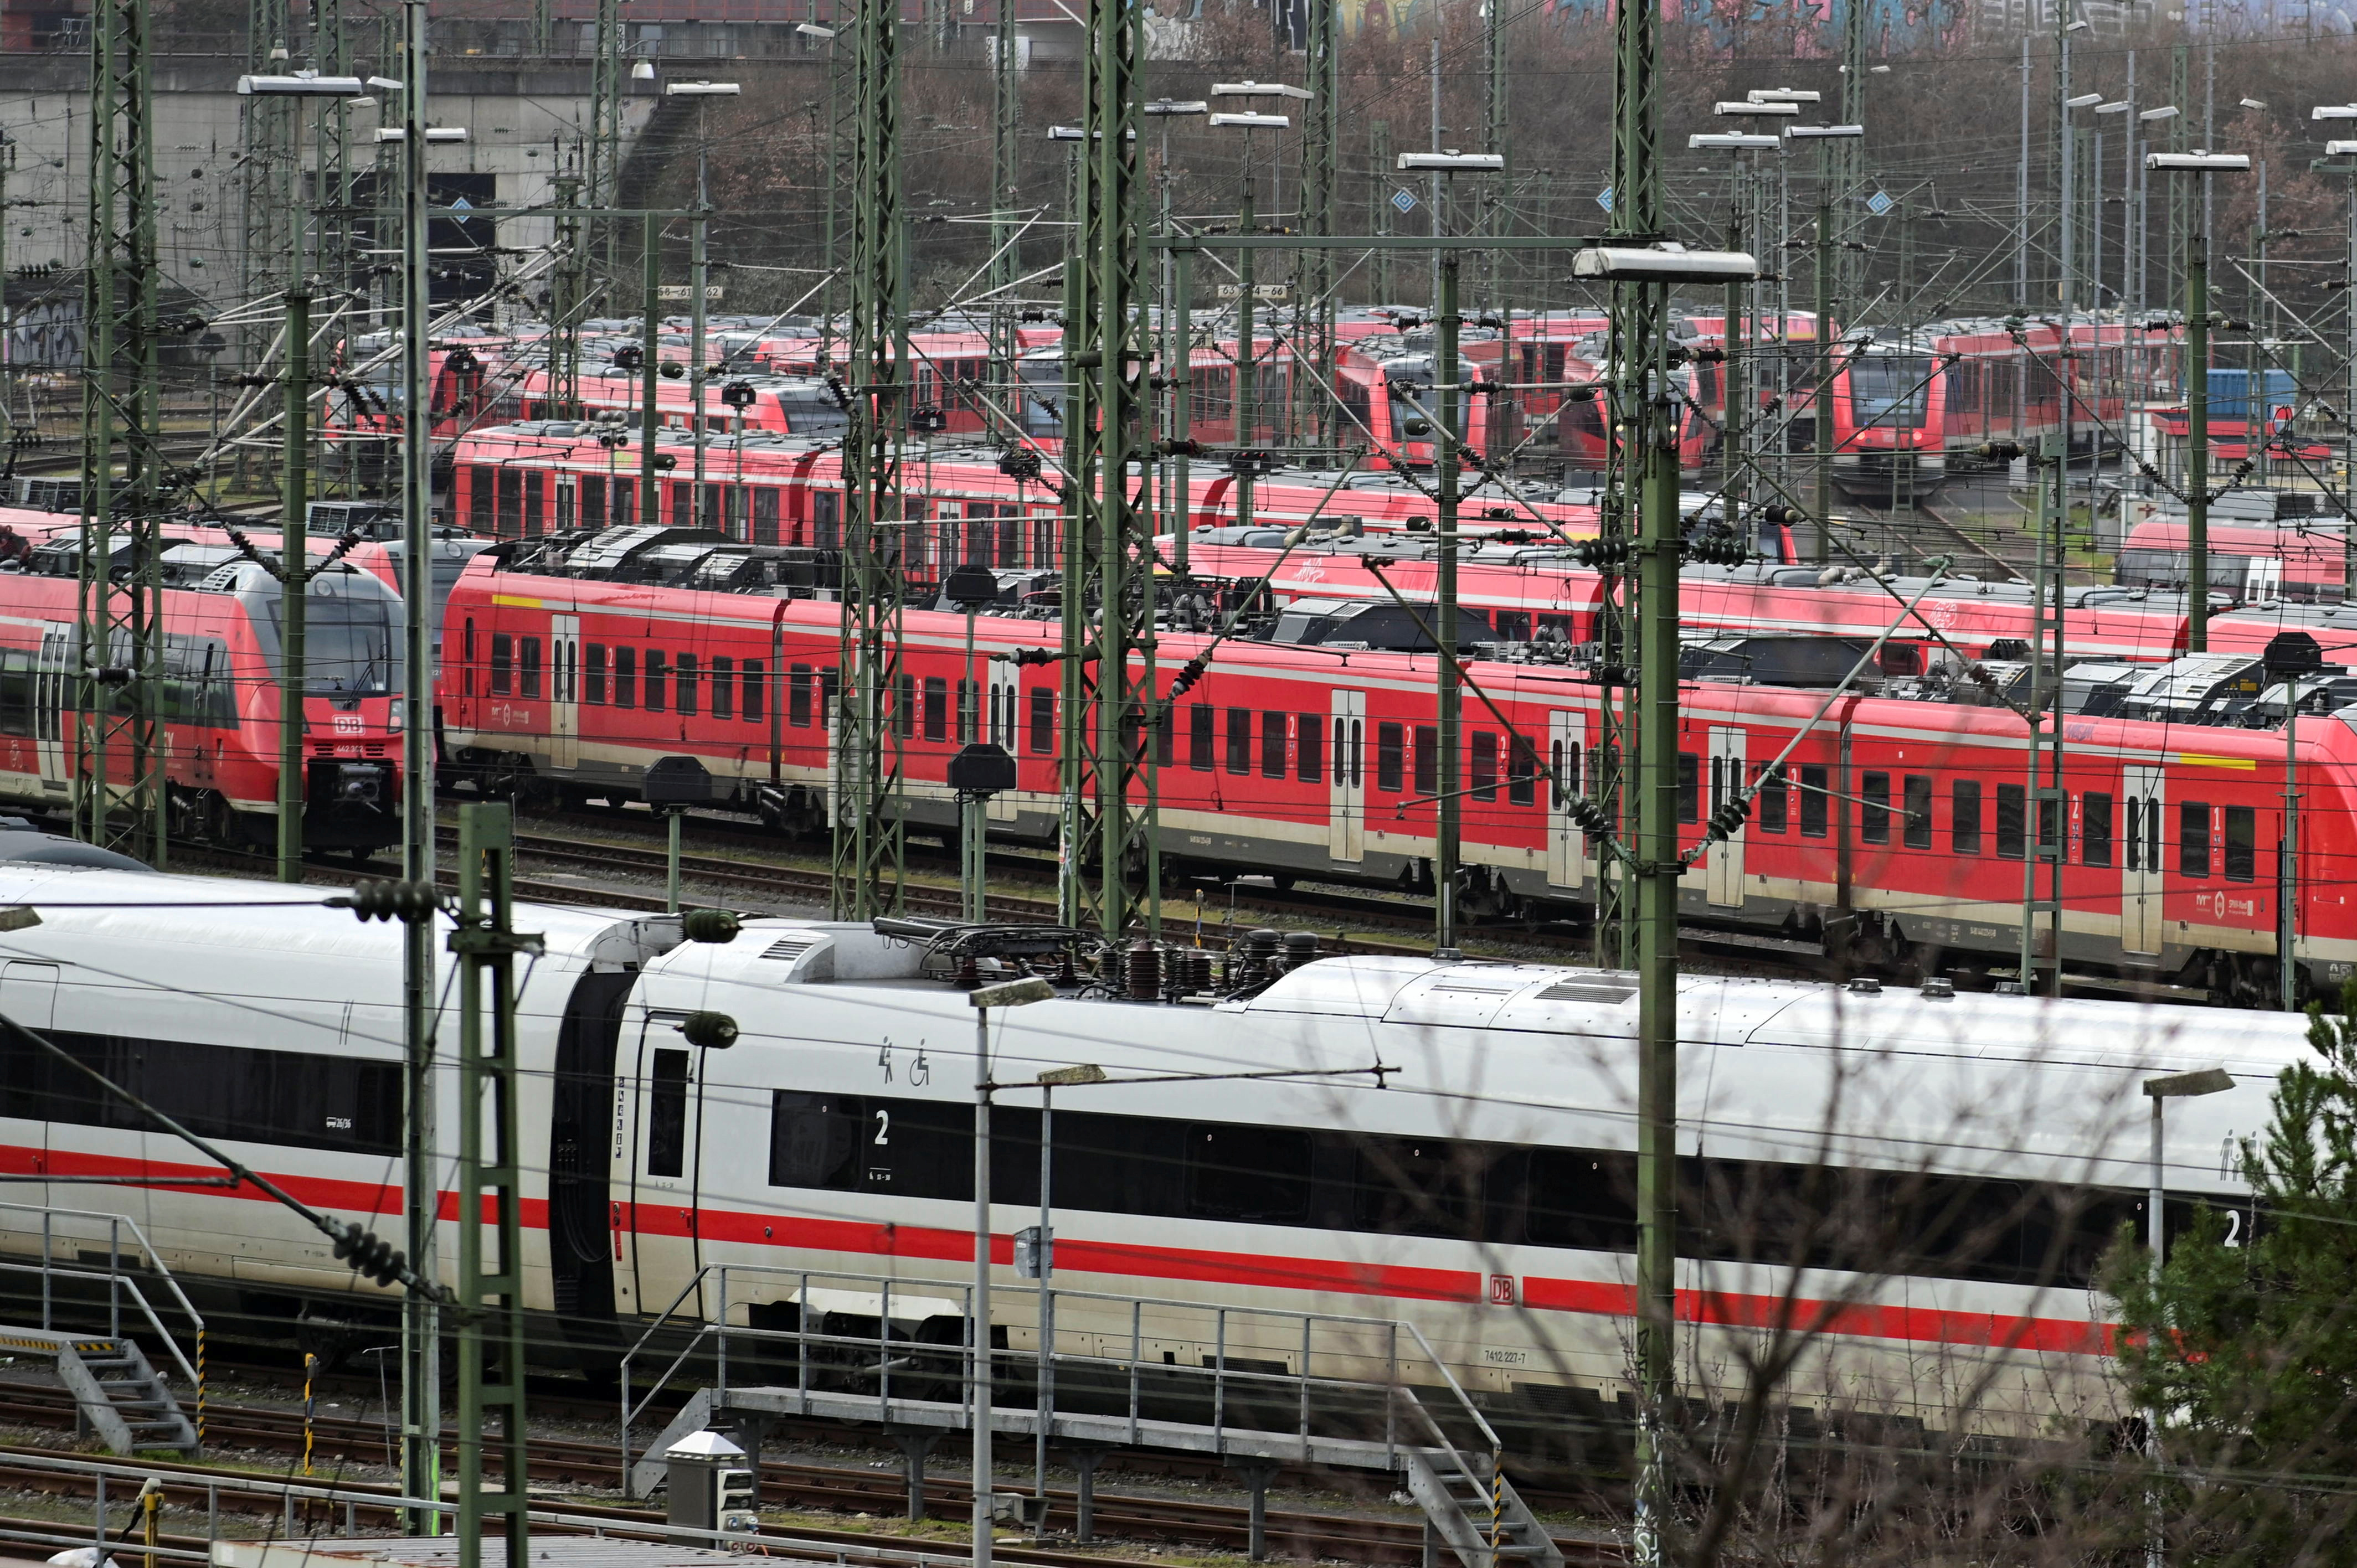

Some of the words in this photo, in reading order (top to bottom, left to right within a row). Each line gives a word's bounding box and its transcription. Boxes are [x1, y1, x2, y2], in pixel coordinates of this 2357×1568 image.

[707, 287, 718, 296] 62
[2174, 553, 2181, 569] 2
[514, 638, 518, 658] 1
[608, 647, 613, 667] 2
[917, 679, 922, 700] 2
[1056, 692, 1062, 713] 2
[334, 717, 363, 734] DB
[1289, 716, 1295, 737] 2
[1407, 725, 1412, 748] 2
[1500, 736, 1506, 759] 2
[1791, 768, 1797, 790] 2
[2072, 795, 2078, 819] 2
[2214, 807, 2220, 831] 1
[875, 1110, 889, 1144] 2
[2224, 1210, 2240, 1247] 2
[1492, 1277, 1512, 1302] DB
[1485, 1350, 1502, 1362] 7412
